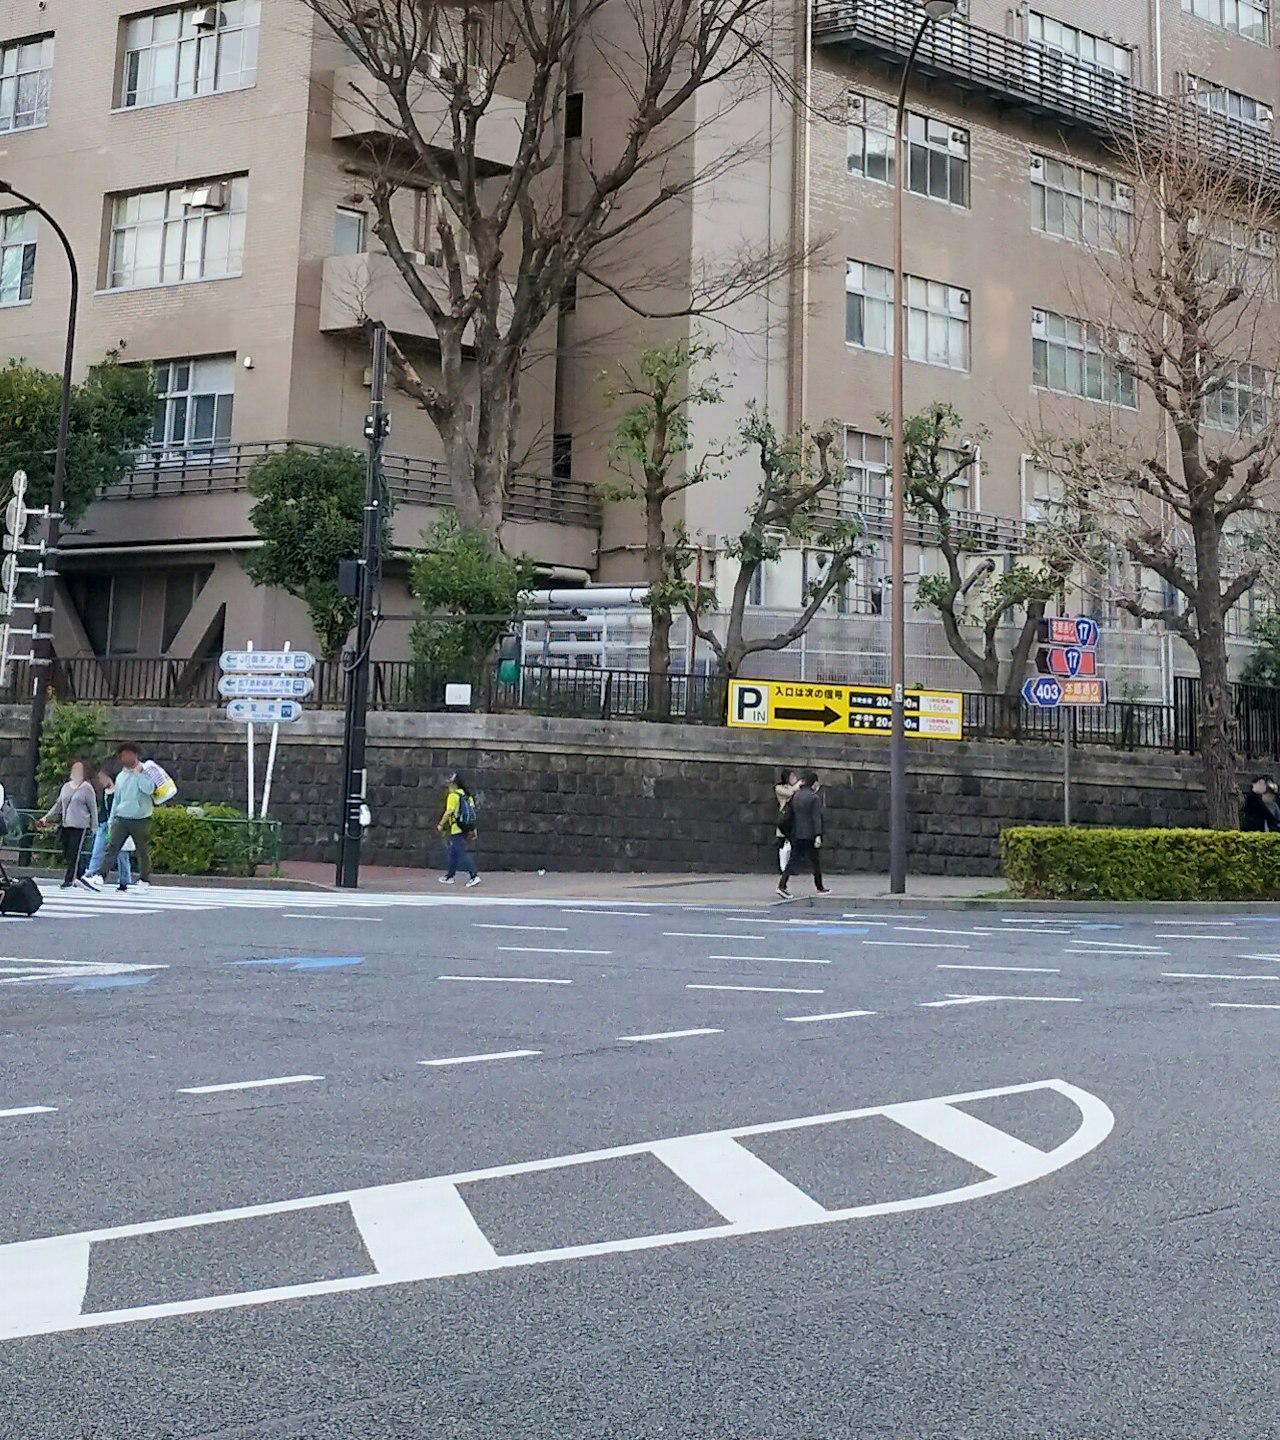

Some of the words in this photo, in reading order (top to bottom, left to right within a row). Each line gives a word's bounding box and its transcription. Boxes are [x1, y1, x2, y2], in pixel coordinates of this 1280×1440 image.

[1078, 623, 1090, 640] 17
[1067, 651, 1079, 669] 17
[775, 686, 844, 700] 入口は次の信号
[1036, 683, 1059, 700] 403
[737, 686, 763, 721] P
[752, 711, 766, 722] IN
